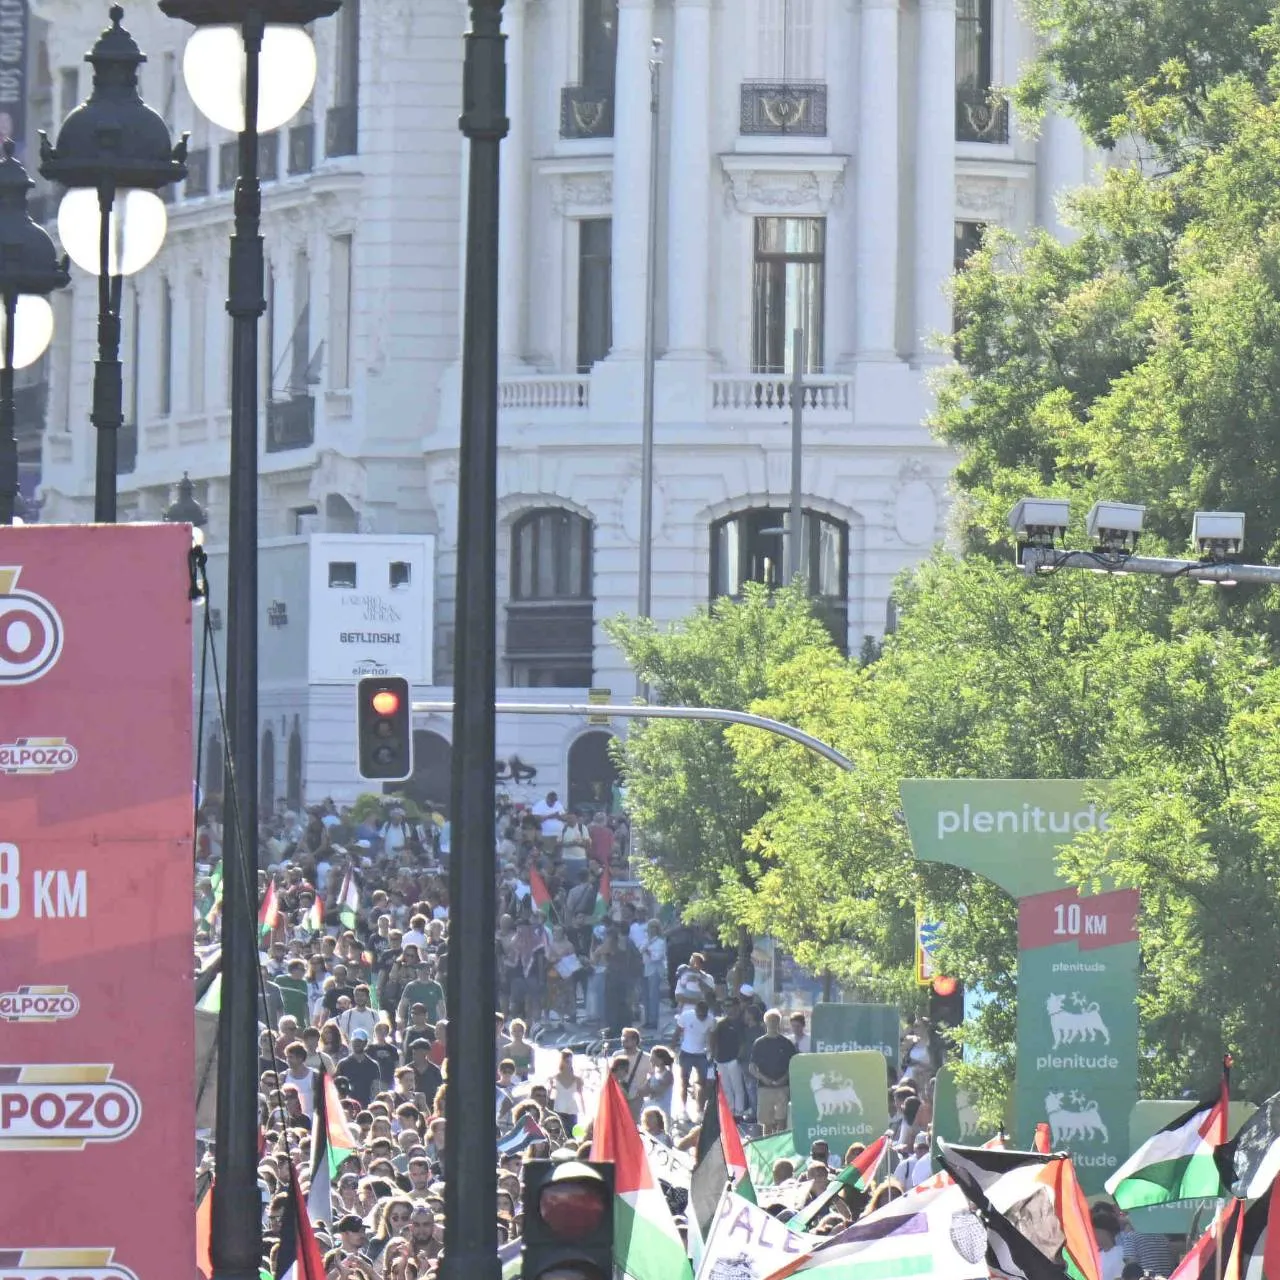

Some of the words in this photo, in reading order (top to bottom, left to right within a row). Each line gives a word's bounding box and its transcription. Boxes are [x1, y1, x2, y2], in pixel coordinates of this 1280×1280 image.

[34, 869, 87, 918] KM
[1054, 904, 1081, 935] 10
[1085, 915, 1107, 935] KM
[1051, 961, 1106, 974] plenitude
[1036, 1053, 1119, 1070] plenitude
[2, 1092, 130, 1129] POZO
[807, 1122, 873, 1140] plenitude
